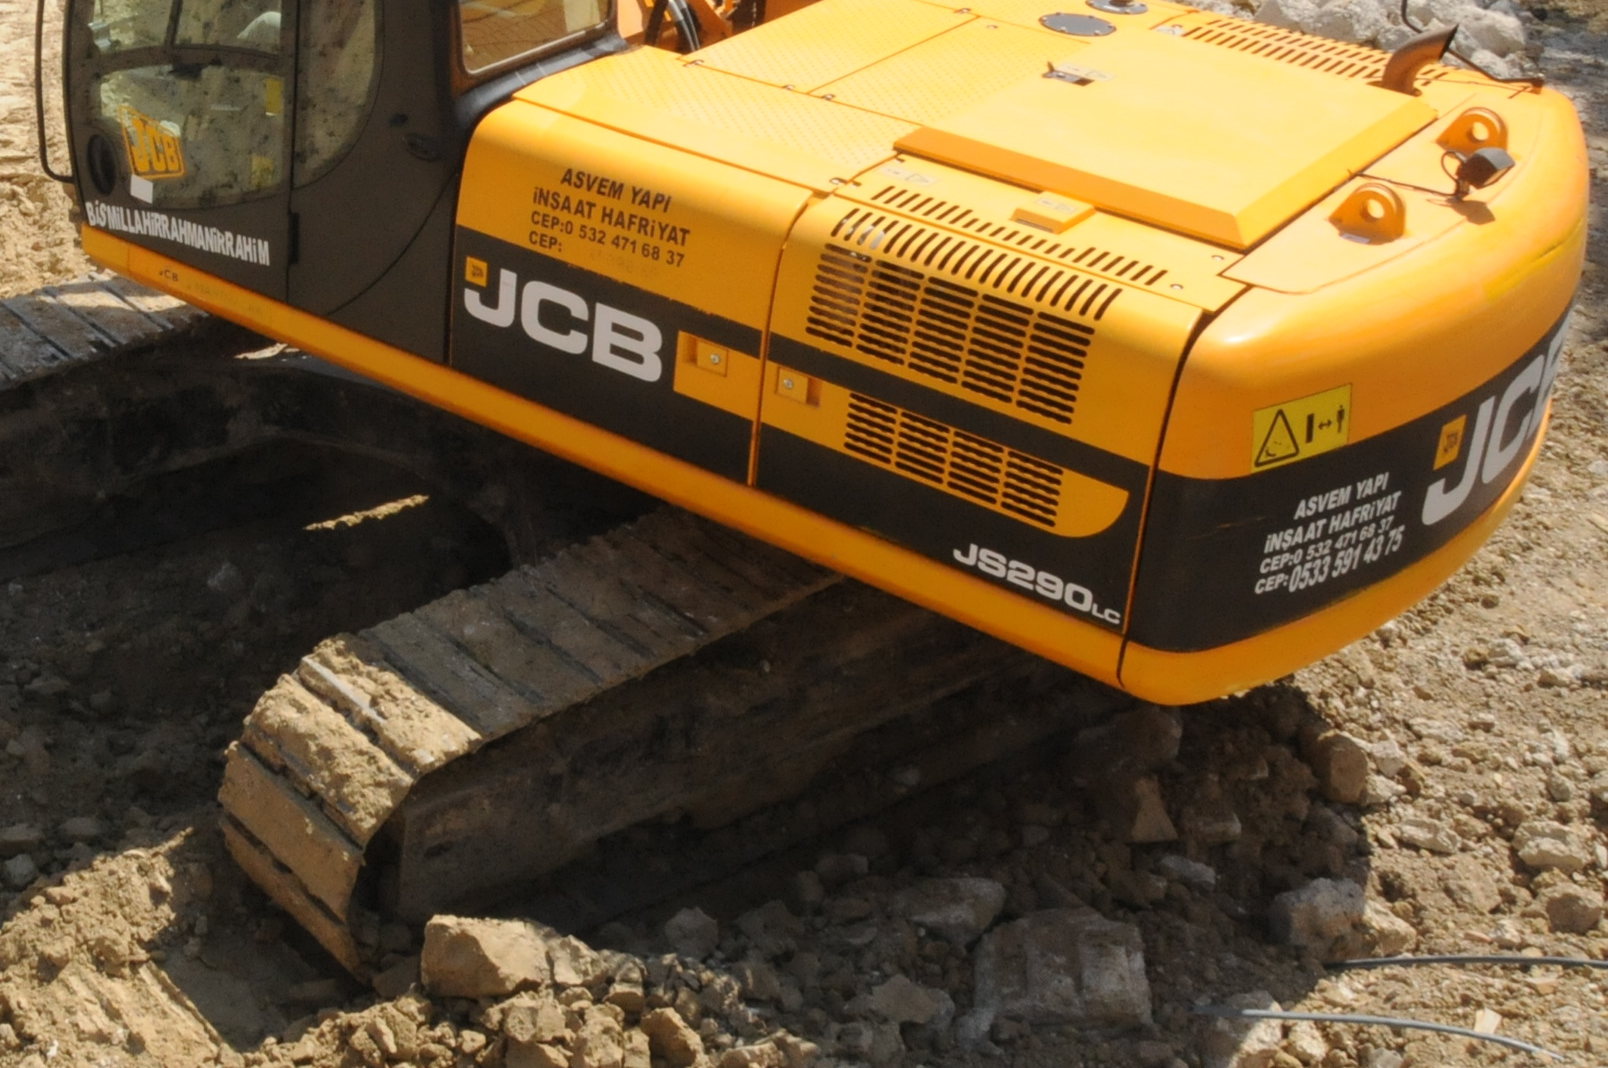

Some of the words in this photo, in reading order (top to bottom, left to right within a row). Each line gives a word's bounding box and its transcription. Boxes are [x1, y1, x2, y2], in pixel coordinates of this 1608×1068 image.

[131, 117, 179, 172] JCB
[560, 168, 624, 200] ASVEM
[631, 185, 672, 213] YAPI
[529, 230, 562, 253] CEP:
[579, 223, 606, 245] 532
[611, 234, 636, 254] 471
[642, 242, 660, 261] 68
[666, 249, 685, 267] 37
[464, 268, 663, 382] JCB
[1293, 485, 1352, 520] ASVEM
[1356, 471, 1390, 500] YAPI
[1306, 539, 1332, 560] 532
[1334, 530, 1358, 550] 471
[1359, 523, 1376, 540] 68
[1378, 515, 1395, 534] 37
[1332, 543, 1363, 578] 591
[1363, 534, 1384, 565] 43
[1385, 525, 1405, 556] 75
